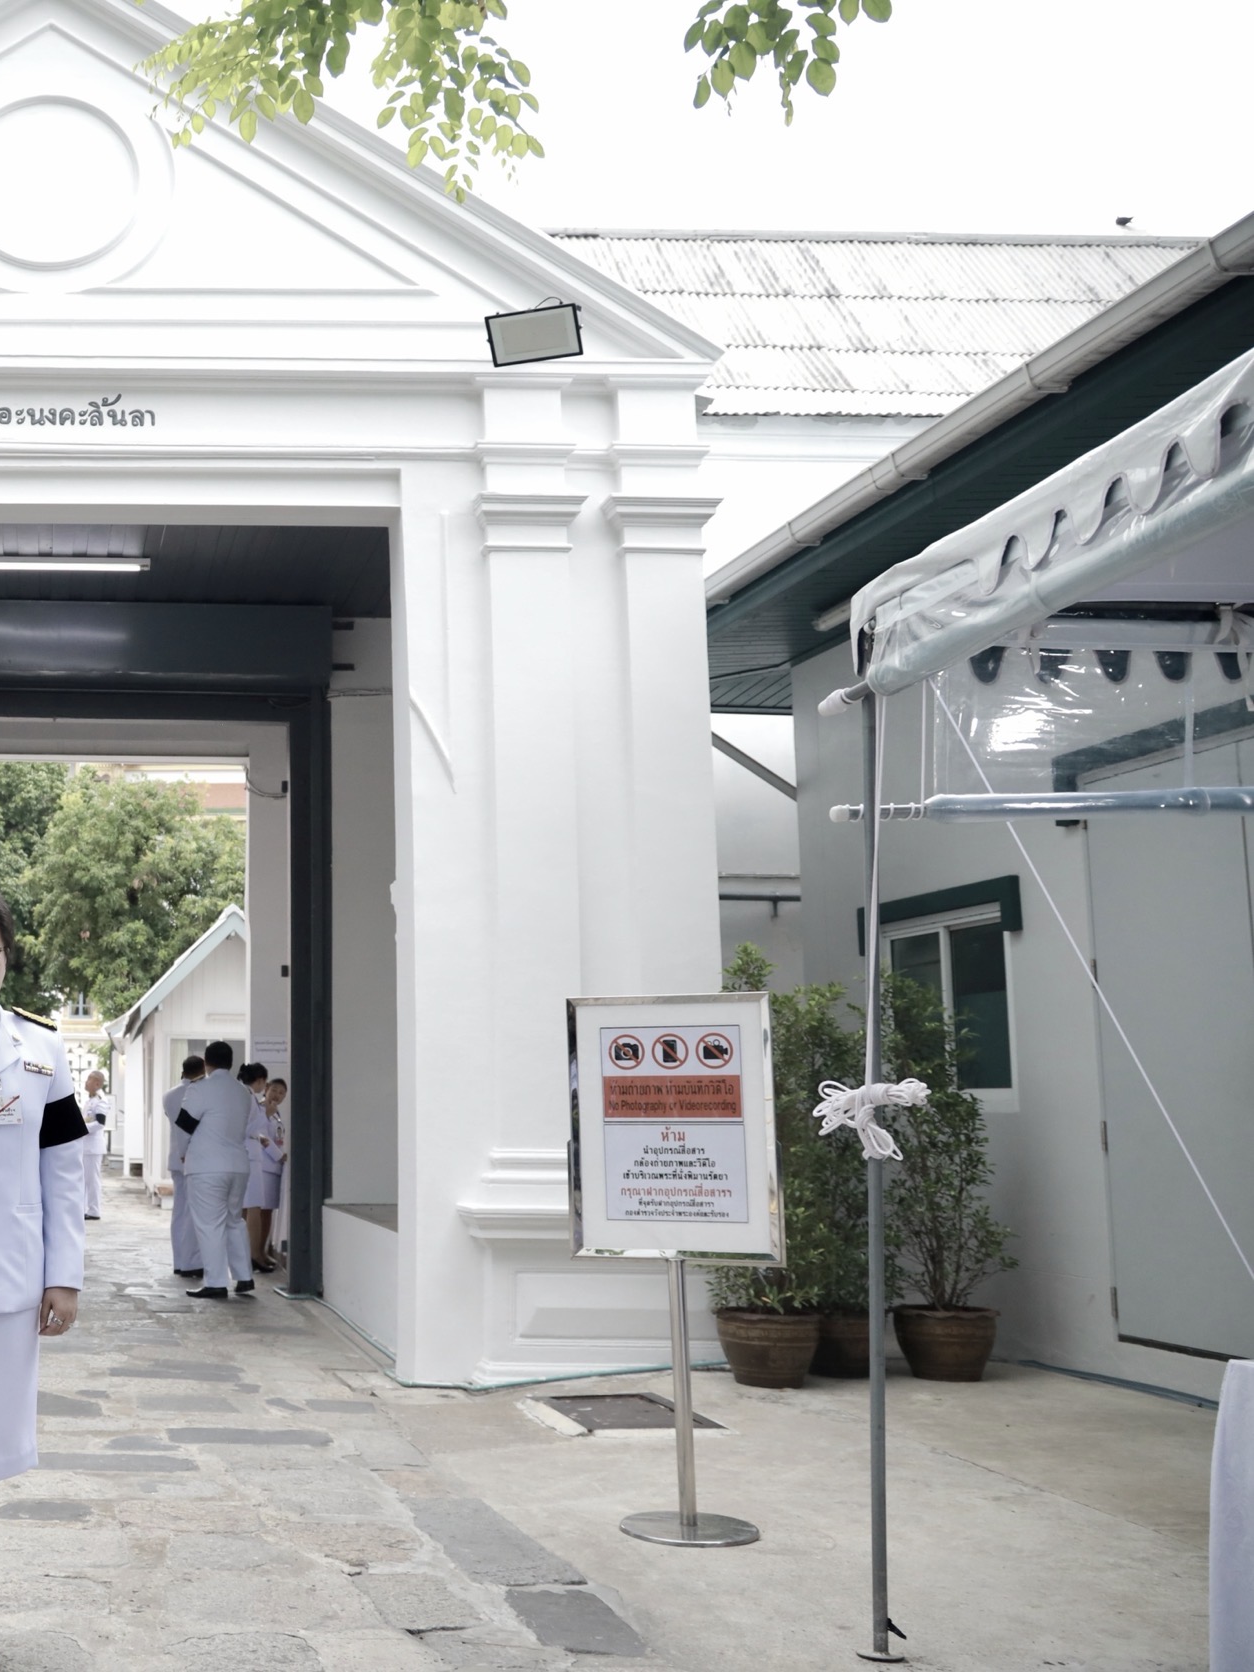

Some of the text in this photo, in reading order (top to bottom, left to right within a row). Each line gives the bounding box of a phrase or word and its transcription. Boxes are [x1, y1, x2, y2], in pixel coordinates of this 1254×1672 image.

[609, 1099, 736, 1114] No Photography or Videorecording
[661, 1126, 686, 1142] ห้าม
